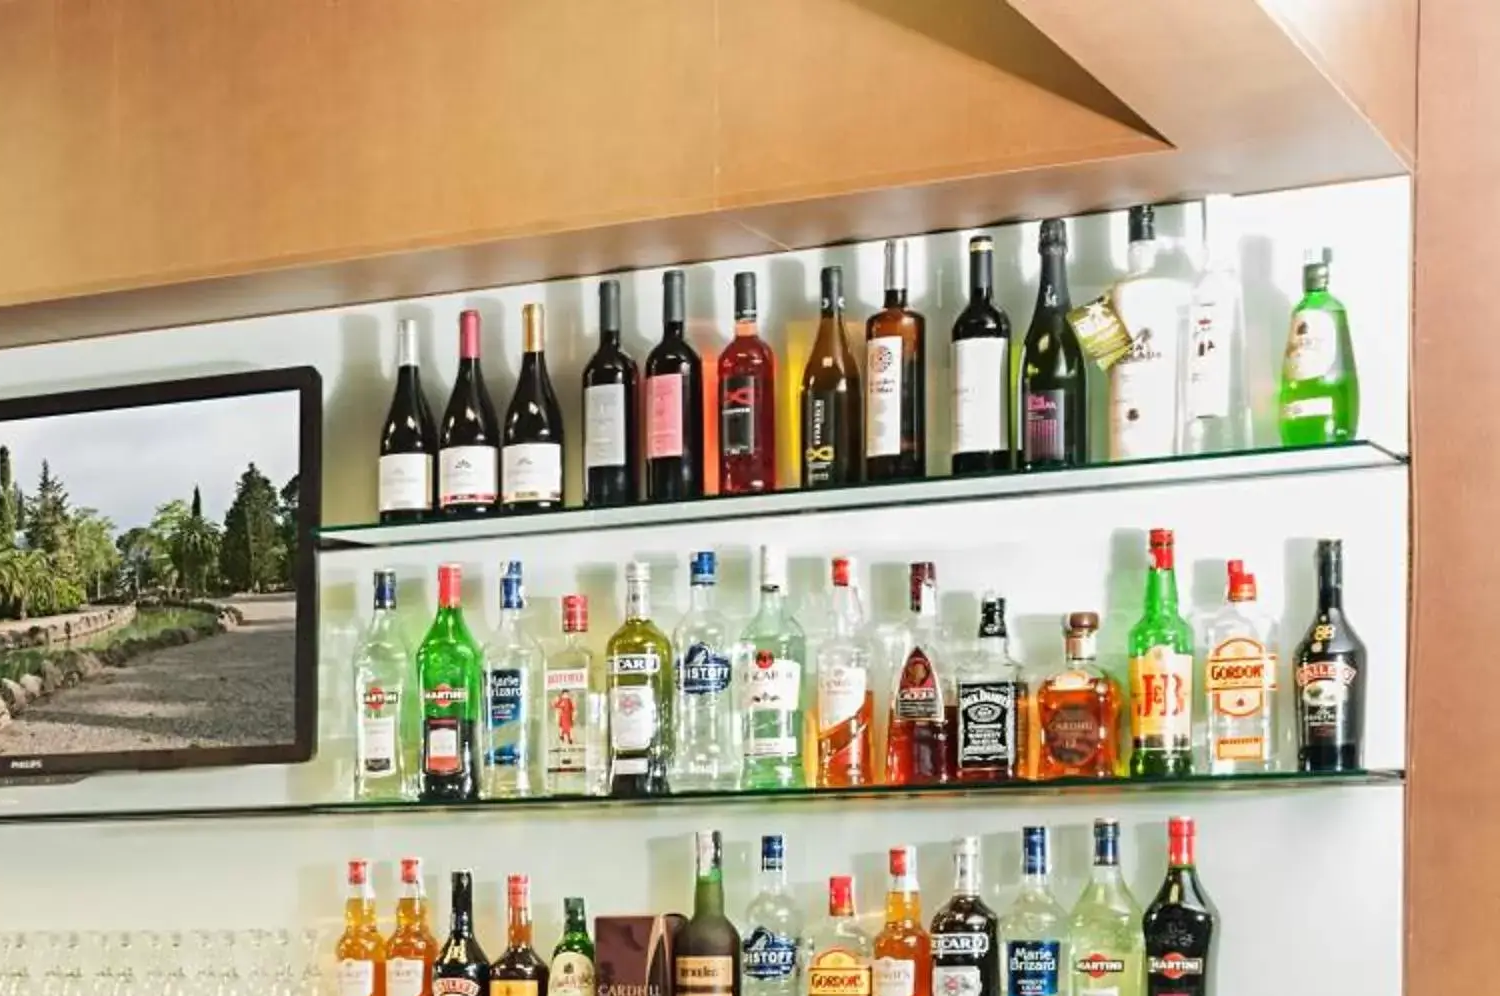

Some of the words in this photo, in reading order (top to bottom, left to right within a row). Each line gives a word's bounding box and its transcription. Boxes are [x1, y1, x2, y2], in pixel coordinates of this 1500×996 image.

[10, 760, 43, 769] PHILIPS
[1014, 947, 1053, 960] Marie
[1009, 957, 1056, 971] Brizard
